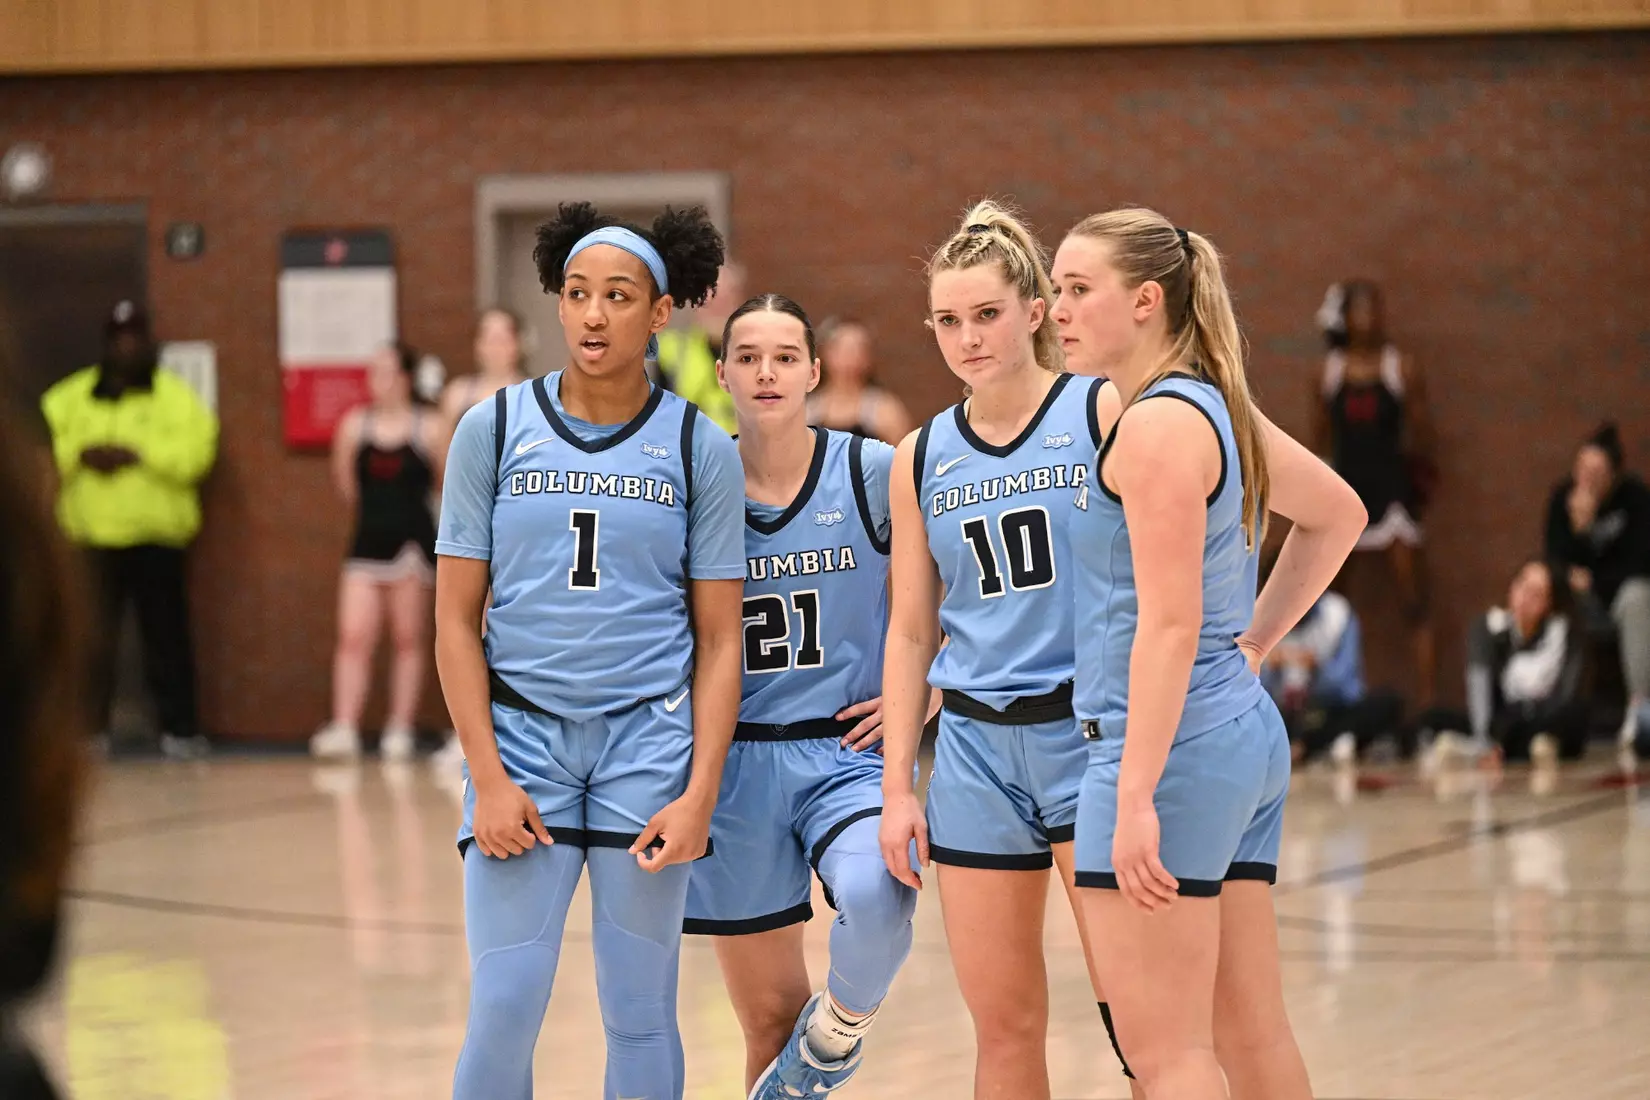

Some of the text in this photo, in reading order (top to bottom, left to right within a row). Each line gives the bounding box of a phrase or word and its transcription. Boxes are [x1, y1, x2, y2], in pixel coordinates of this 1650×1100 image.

[511, 470, 675, 507] COLUMBIA
[933, 464, 1088, 517] COLUMBIA
[568, 509, 600, 591] 1
[745, 546, 857, 582] UMBIA
[960, 505, 1056, 600] 10
[742, 589, 824, 674] 21
